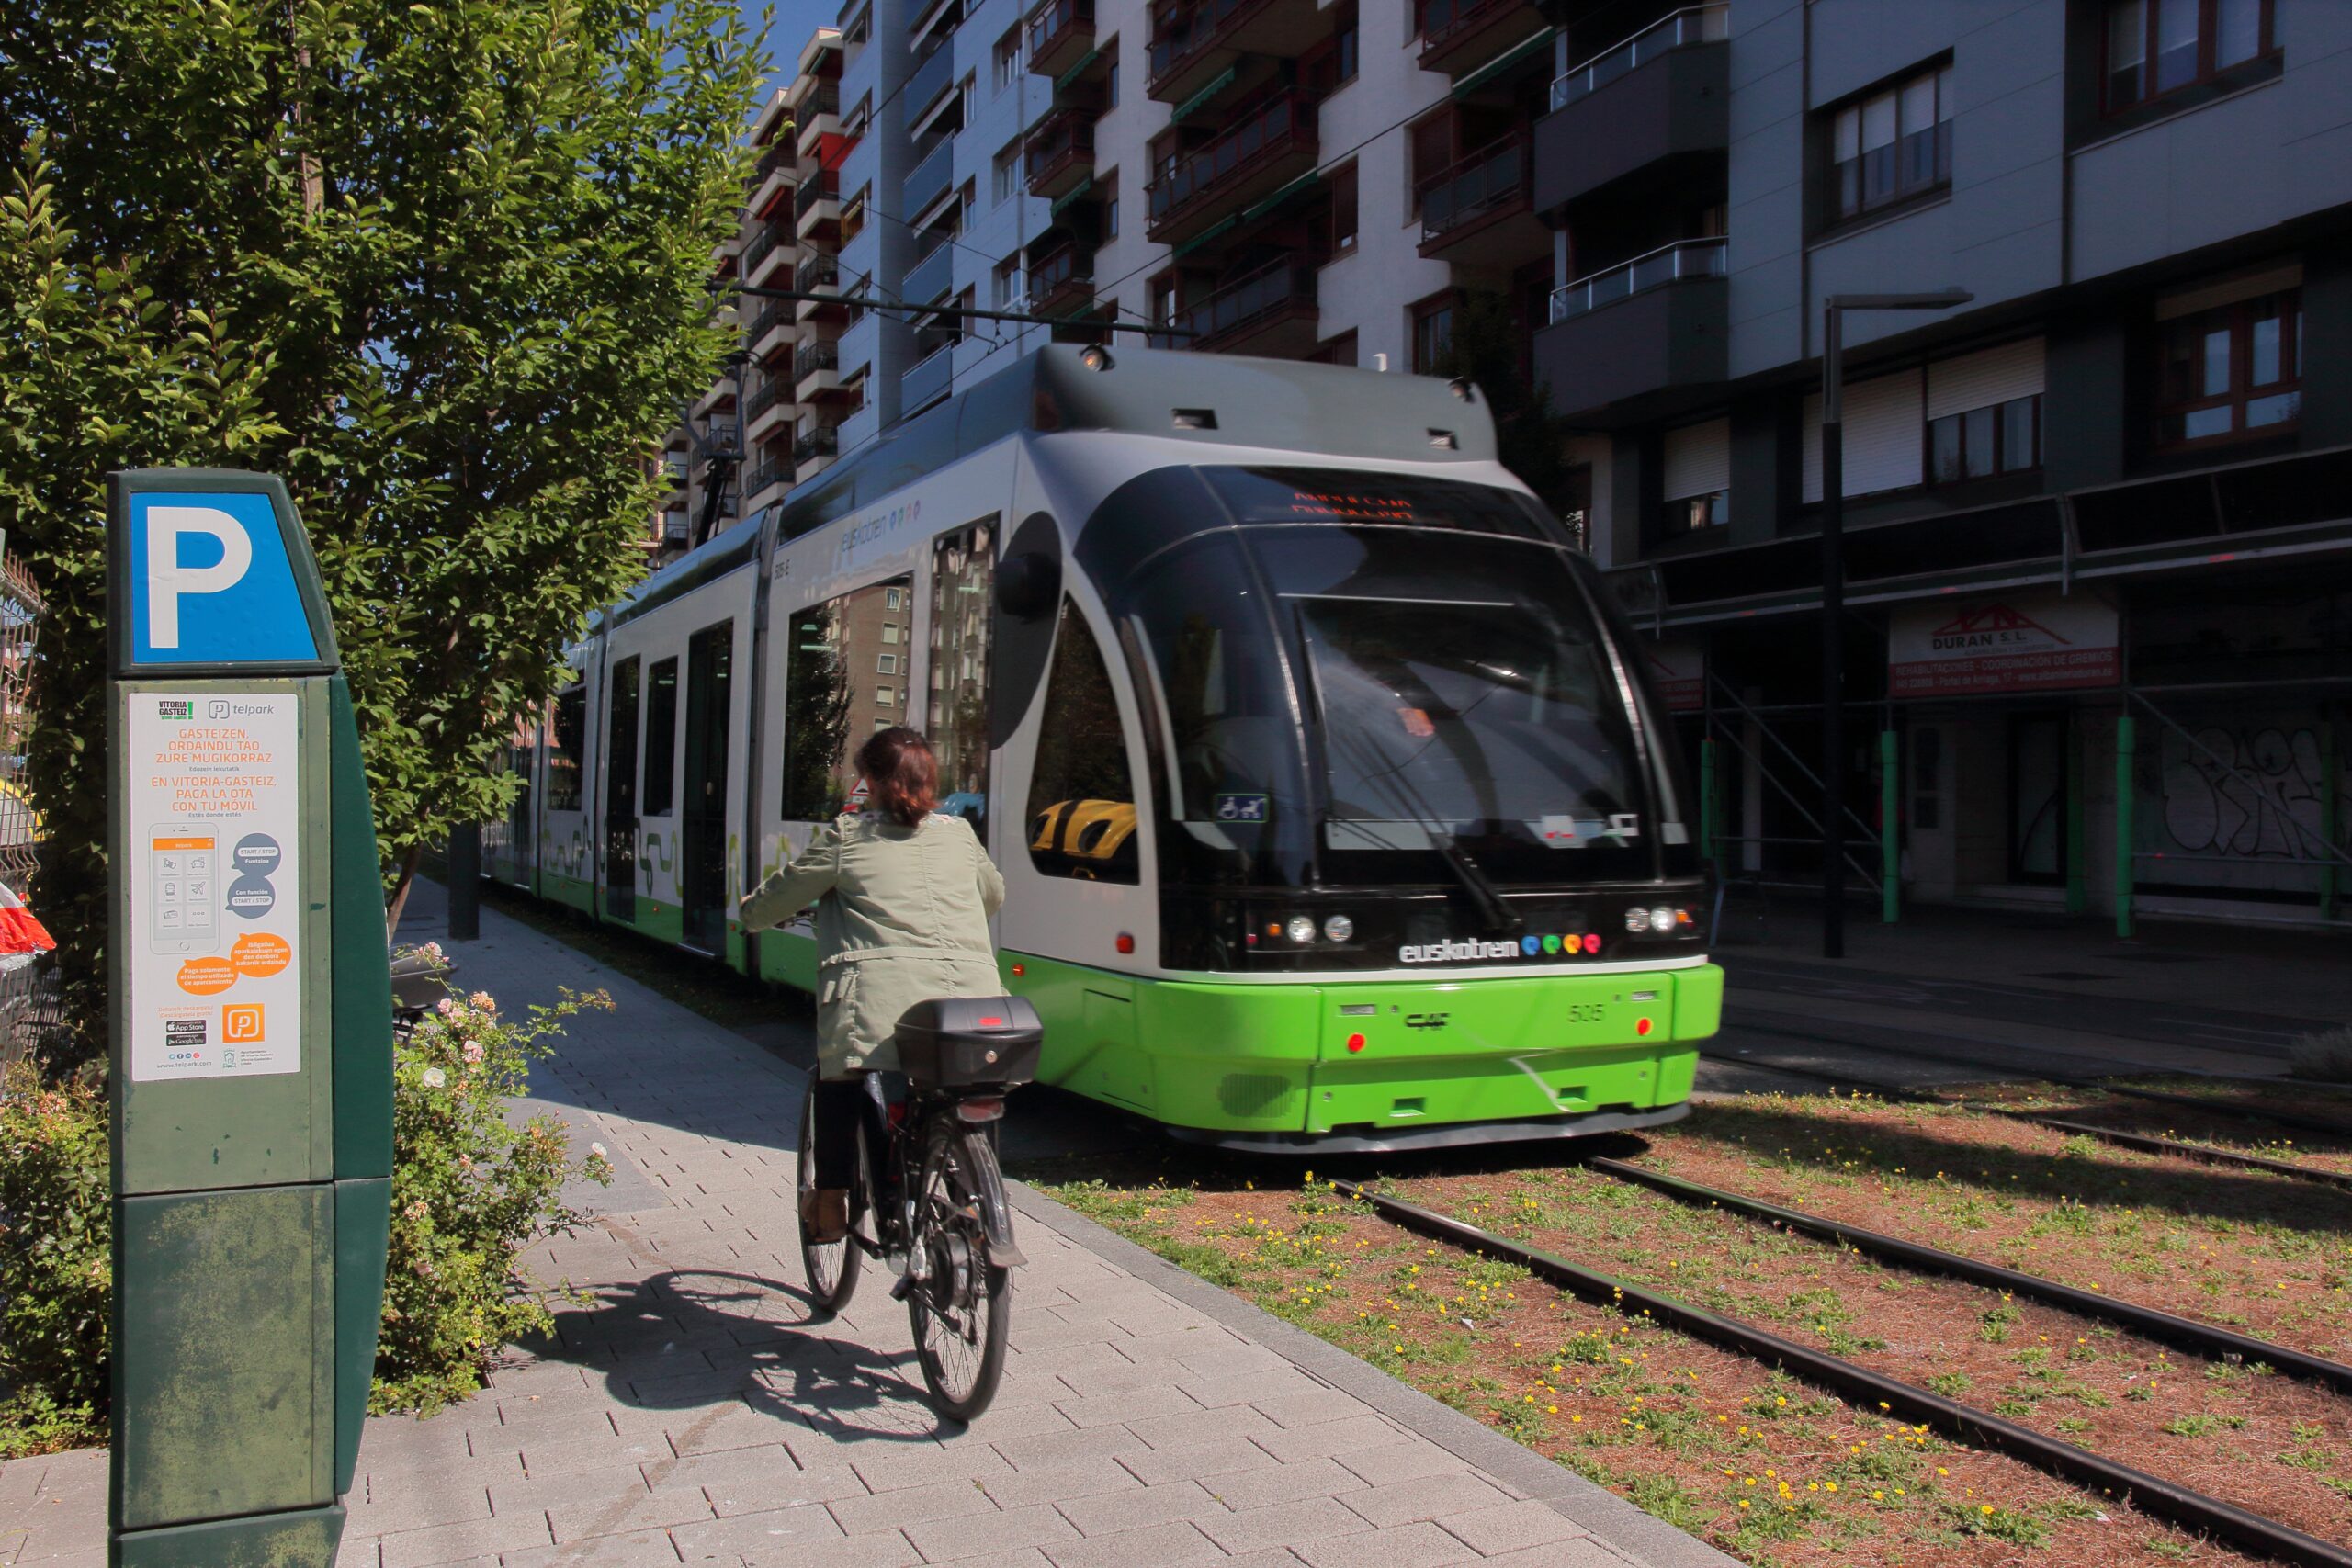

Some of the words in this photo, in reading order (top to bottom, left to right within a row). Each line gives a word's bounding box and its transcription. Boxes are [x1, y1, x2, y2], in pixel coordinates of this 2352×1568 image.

[147, 506, 252, 648] P
[1932, 635, 1993, 649] DURAN
[2069, 651, 2113, 665] GREMIOS
[233, 704, 275, 716] telpark
[179, 729, 249, 739] GASTEIZEN,
[168, 741, 233, 750] ORDAINDU
[237, 741, 260, 750] TAO
[156, 754, 188, 763] ZURE
[192, 753, 272, 763] MUGIKORRAZ
[151, 777, 167, 786] EN
[172, 776, 277, 787] VITORIA-GASTEIZ,
[176, 790, 209, 798] PAGA
[212, 790, 227, 798] LA
[230, 789, 254, 798] OTA
[172, 802, 197, 811] CON
[200, 802, 217, 811] TU
[220, 799, 258, 811] MÓVIL
[1399, 937, 1519, 963] euskotren
[1567, 1004, 1605, 1023] 505
